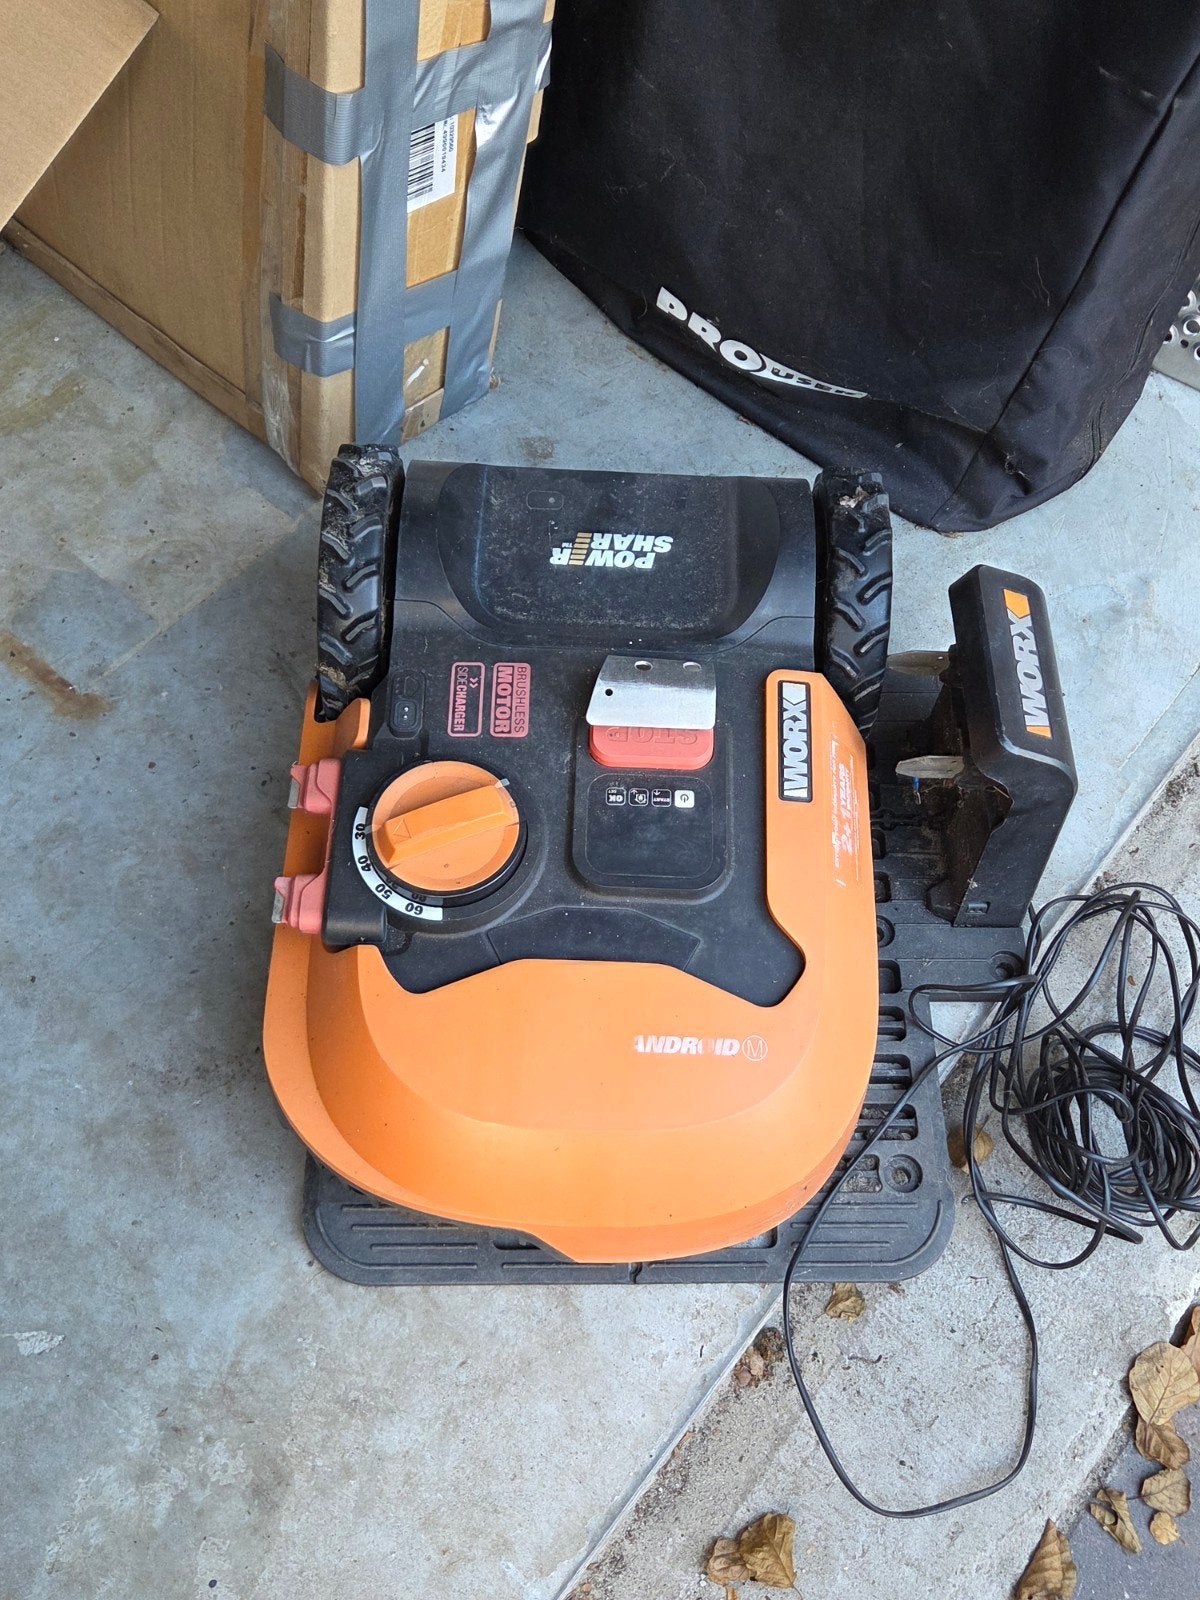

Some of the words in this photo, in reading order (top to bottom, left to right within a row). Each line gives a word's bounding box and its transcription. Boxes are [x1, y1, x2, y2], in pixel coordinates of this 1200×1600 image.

[574, 532, 673, 553] SHARE
[549, 547, 656, 569] POWER
[1007, 608, 1050, 726] WORX
[495, 666, 513, 734] MOTOR
[513, 666, 528, 733] BRUSHLESS
[783, 698, 808, 790] WORX
[608, 794, 624, 802] OK
[354, 823, 367, 840] 30
[357, 855, 372, 872] 40
[375, 883, 393, 900] 50
[404, 902, 424, 916] 60
